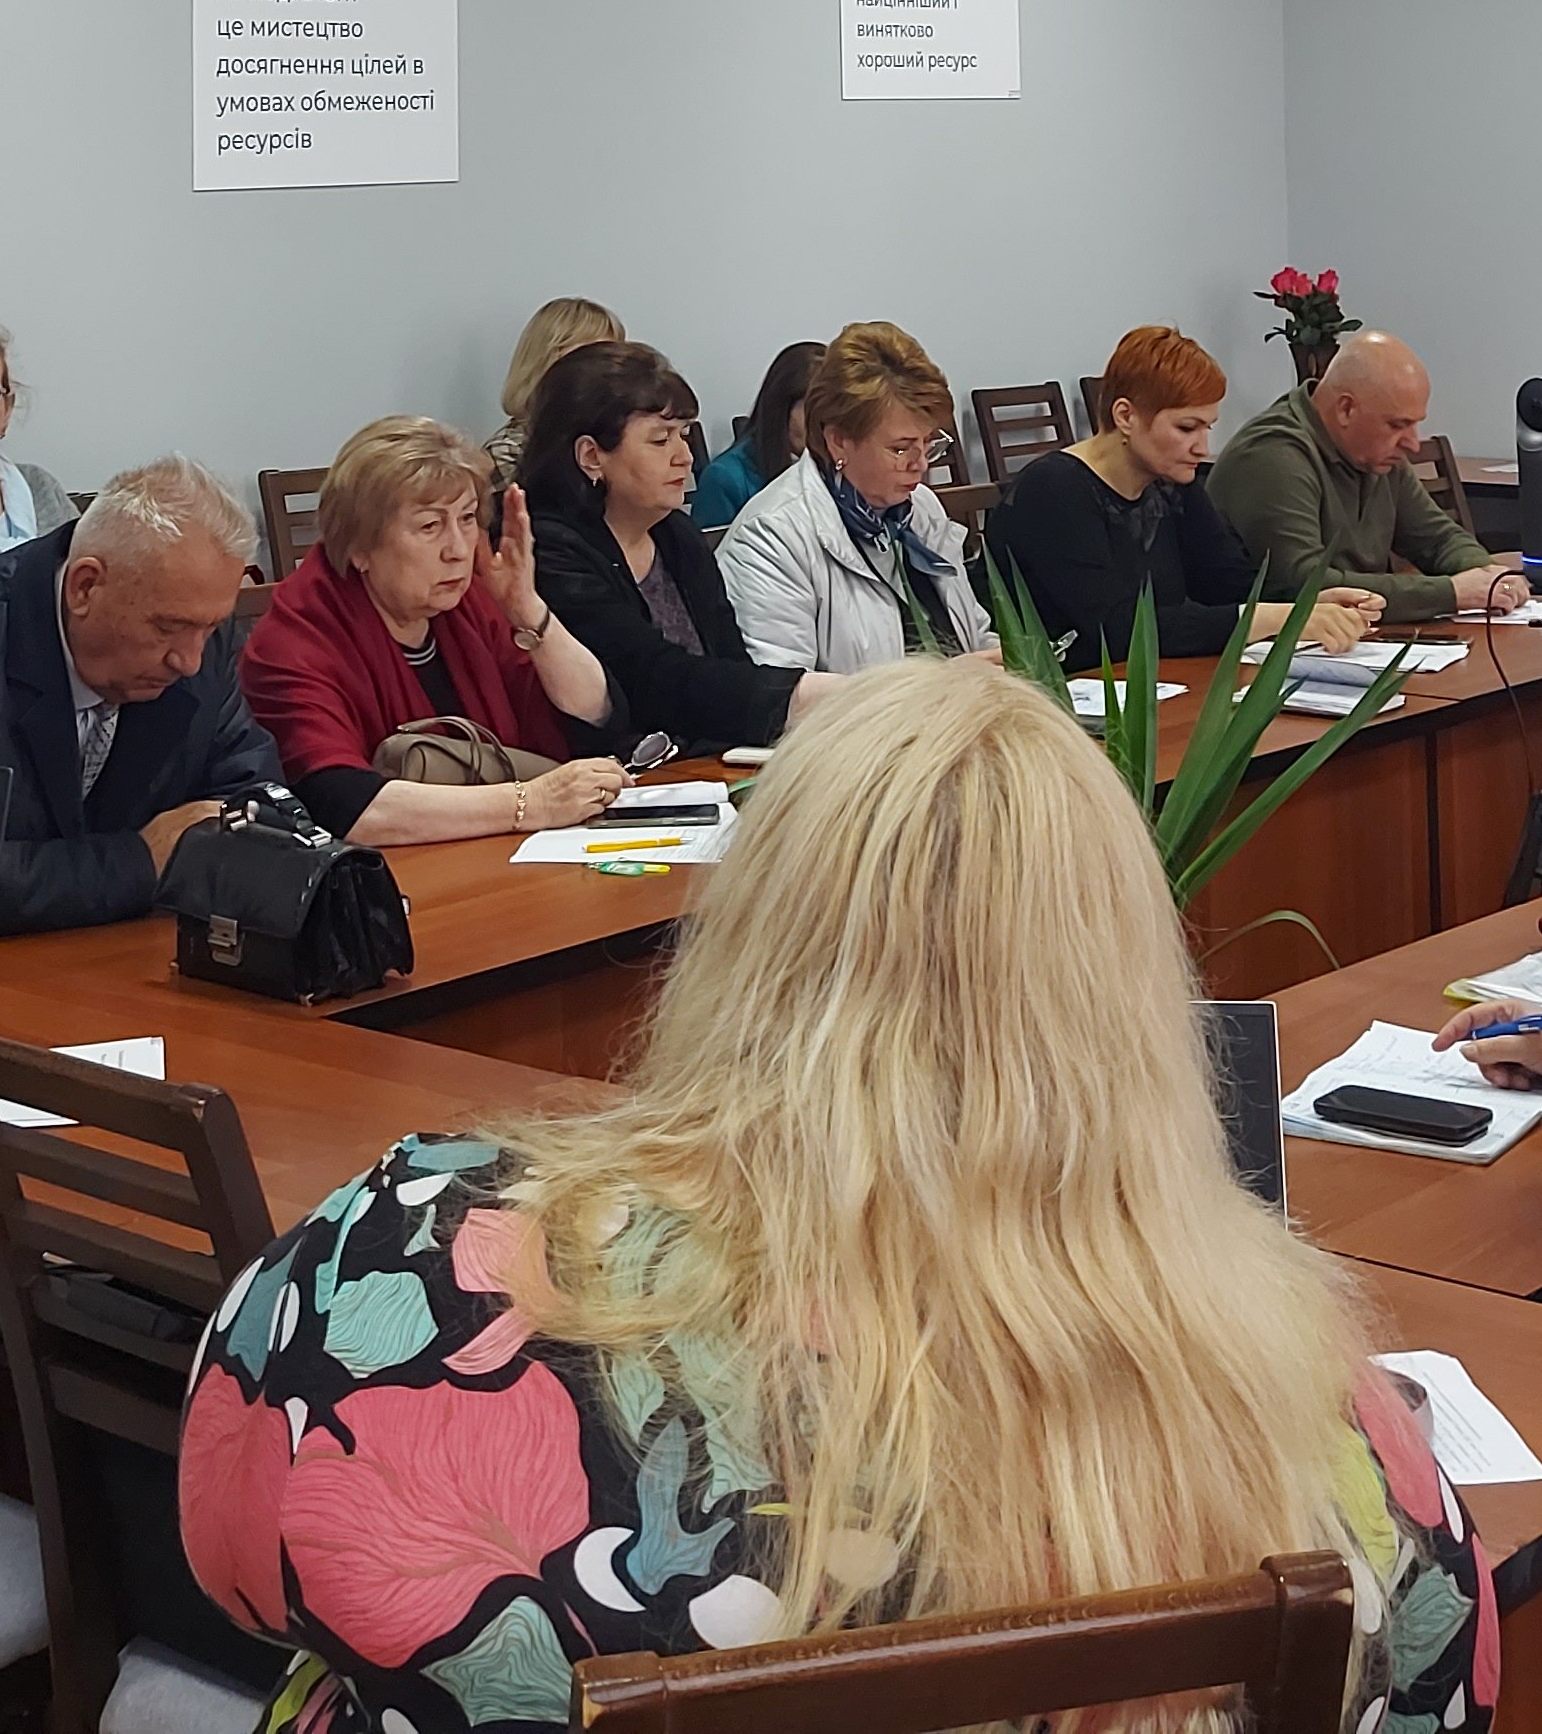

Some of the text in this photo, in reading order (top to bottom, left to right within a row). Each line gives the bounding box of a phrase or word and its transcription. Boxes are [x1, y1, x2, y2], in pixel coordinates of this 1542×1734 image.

[217, 19, 364, 40] це мистецтво
[857, 24, 933, 38] винятково
[216, 53, 424, 78] досягнення цілей в
[857, 51, 978, 72] хороший ресурс
[216, 89, 435, 117] умовах обмеженості
[217, 127, 312, 155] ресурсів
